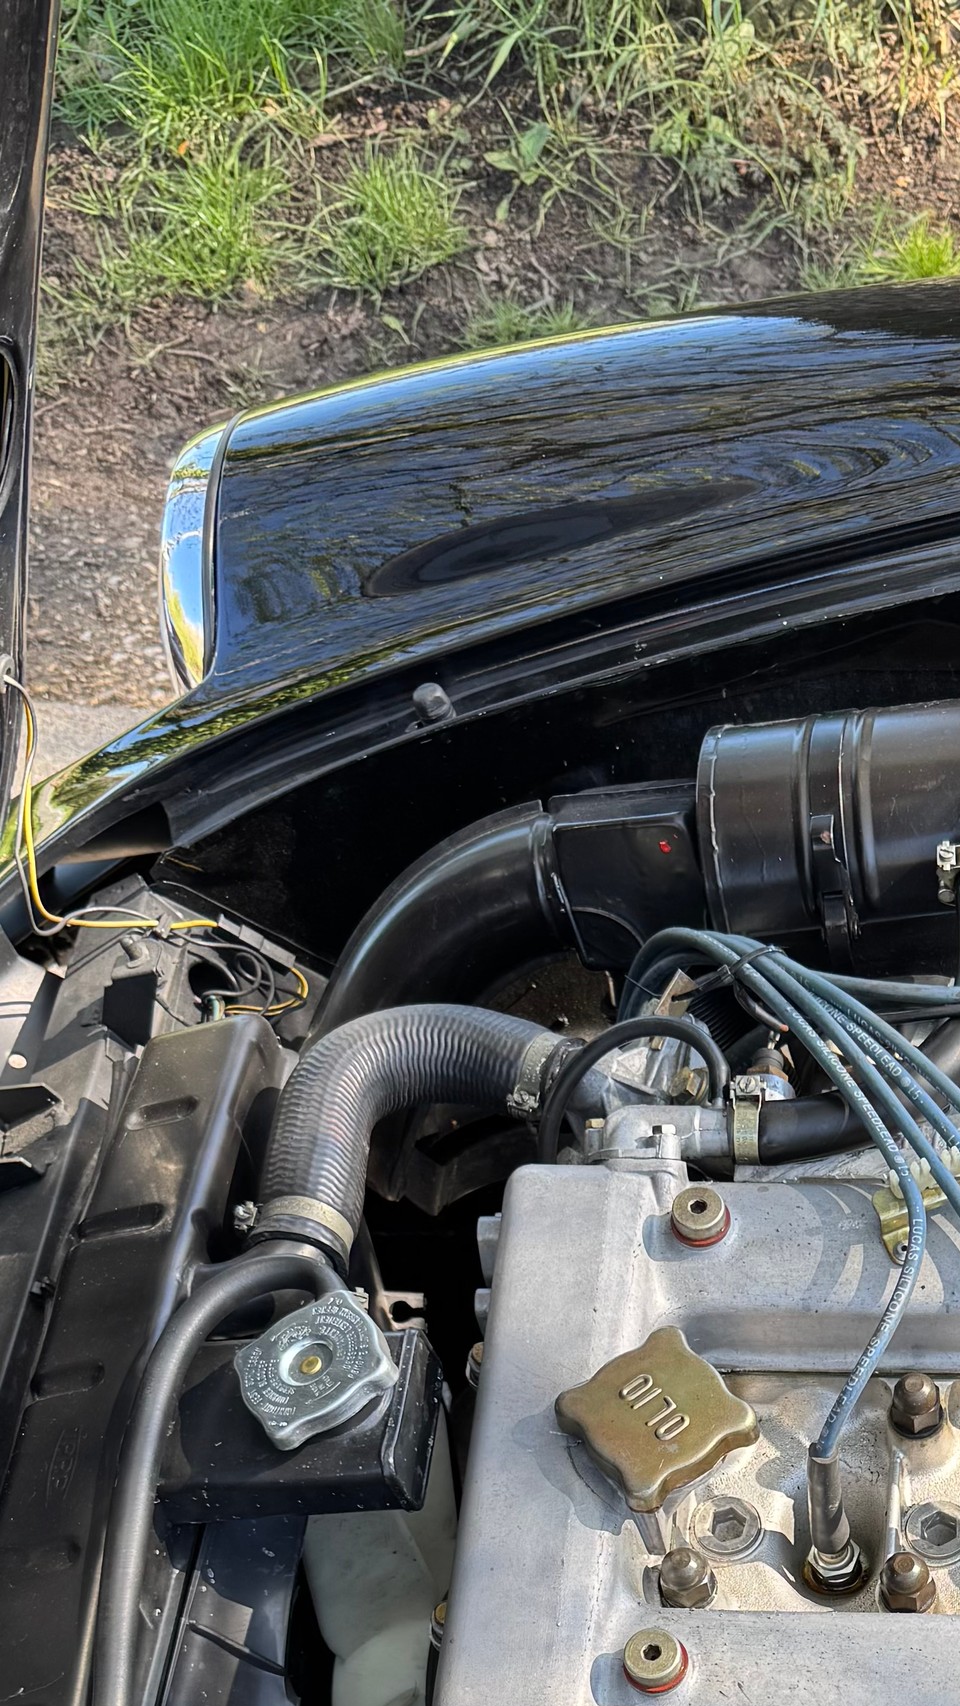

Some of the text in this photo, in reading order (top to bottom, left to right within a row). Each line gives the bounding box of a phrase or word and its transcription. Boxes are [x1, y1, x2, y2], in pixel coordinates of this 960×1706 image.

[786, 1005, 817, 1038] LUCAS
[816, 1038, 857, 1088] SILICONE
[853, 1090, 899, 1152] SPEEDLEAD
[846, 1022, 901, 1078] SPEEDLEAD
[826, 1218, 924, 1428] LUCAS SILICONE SPEEDLEAD
